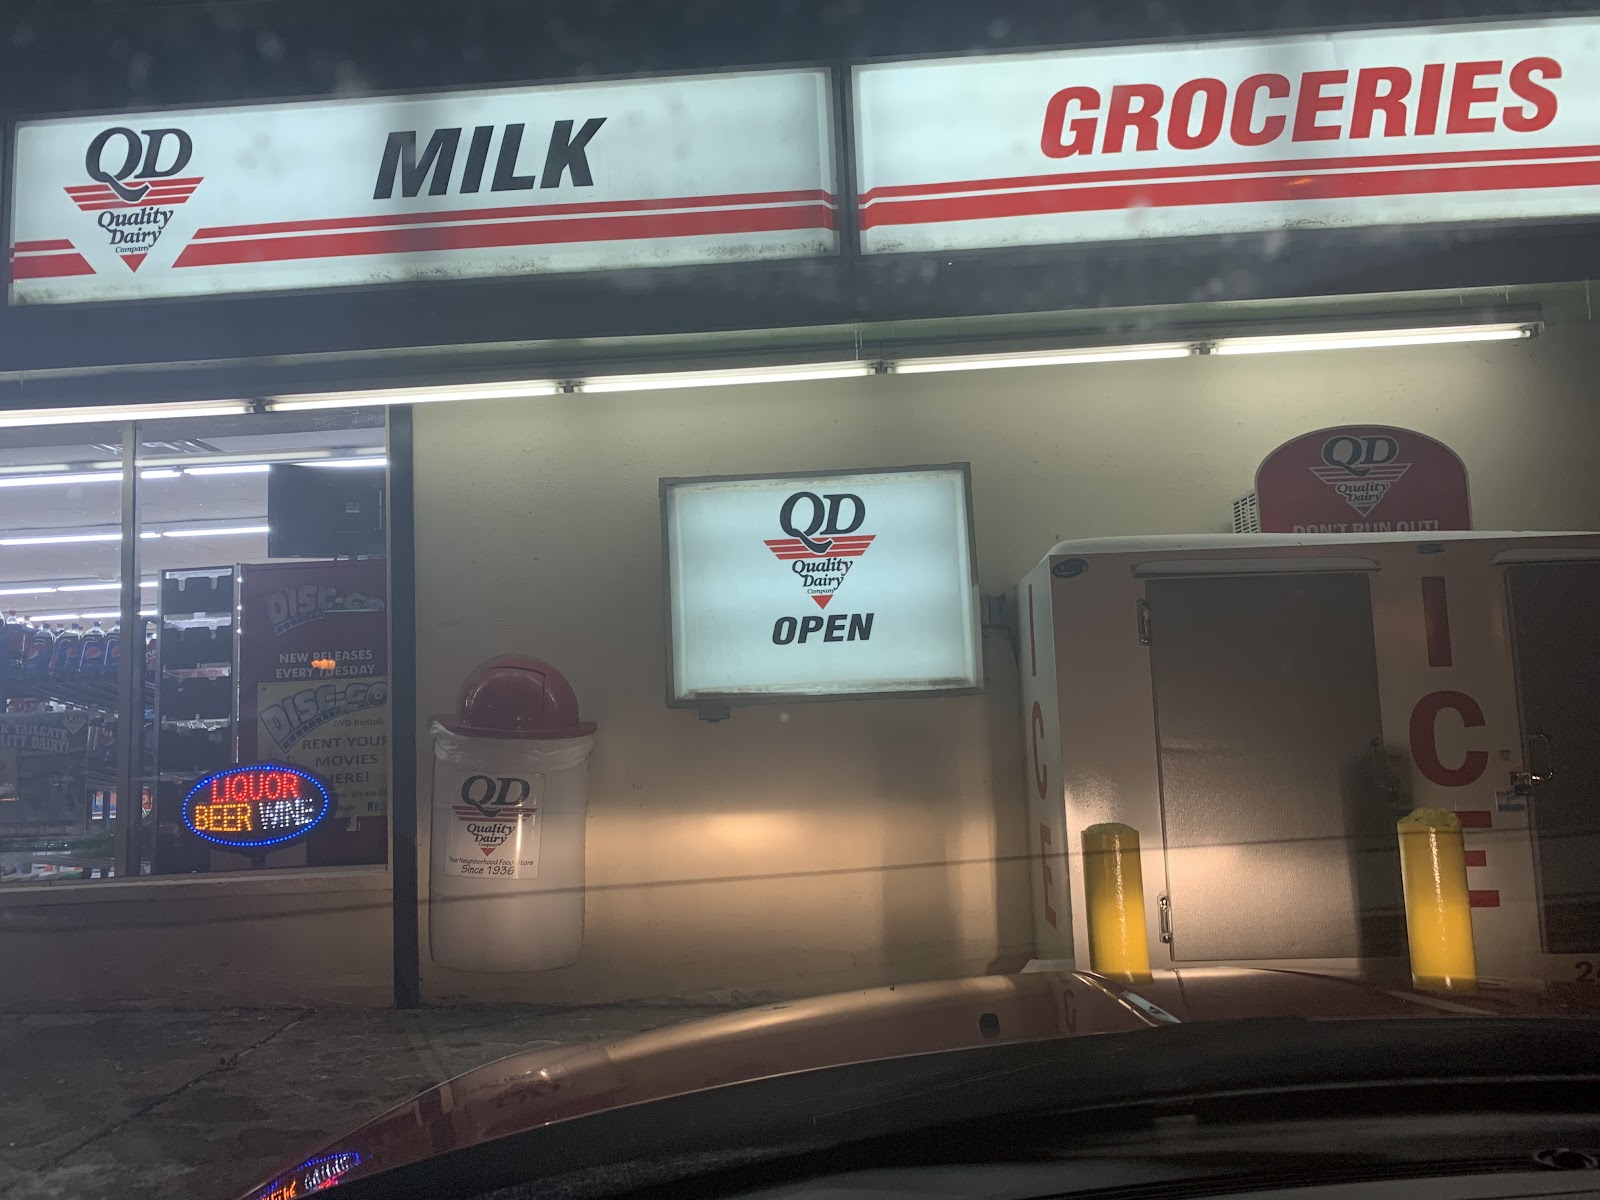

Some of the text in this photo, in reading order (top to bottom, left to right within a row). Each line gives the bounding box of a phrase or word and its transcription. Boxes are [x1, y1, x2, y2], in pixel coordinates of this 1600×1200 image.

[1040, 57, 1562, 159] GROCERIES
[86, 127, 193, 202] QD
[373, 117, 608, 200] MILK
[97, 207, 174, 233] Quality
[109, 228, 162, 247] Dairy
[115, 245, 150, 254] Company
[1322, 436, 1398, 477] QD
[1337, 482, 1389, 496] Quality
[1347, 492, 1382, 503] Dairy
[779, 491, 866, 554] QD
[1293, 524, 1348, 534] DON'T
[1352, 521, 1391, 533] RUN
[792, 557, 853, 578] Quality
[802, 574, 844, 590] Dairy
[772, 613, 875, 645] OPEN
[279, 649, 373, 664] NEW RELEASES
[275, 664, 376, 679] EVERY TUESDAY
[333, 717, 385, 728] DVD Rentals
[15, 724, 68, 741] TAILGATE
[32, 736, 69, 755] DAIRY!
[302, 737, 342, 750] RENT
[315, 754, 378, 767] MOVIES
[211, 772, 299, 803] LIQUOR
[461, 775, 531, 818] QD
[194, 798, 315, 832] BEER WINE
[466, 823, 516, 836] Quality
[474, 833, 507, 846] Dairy
[459, 857, 498, 866] Neighborhood
[461, 864, 515, 876] Since 1936
[1574, 960, 1600, 983] 2
